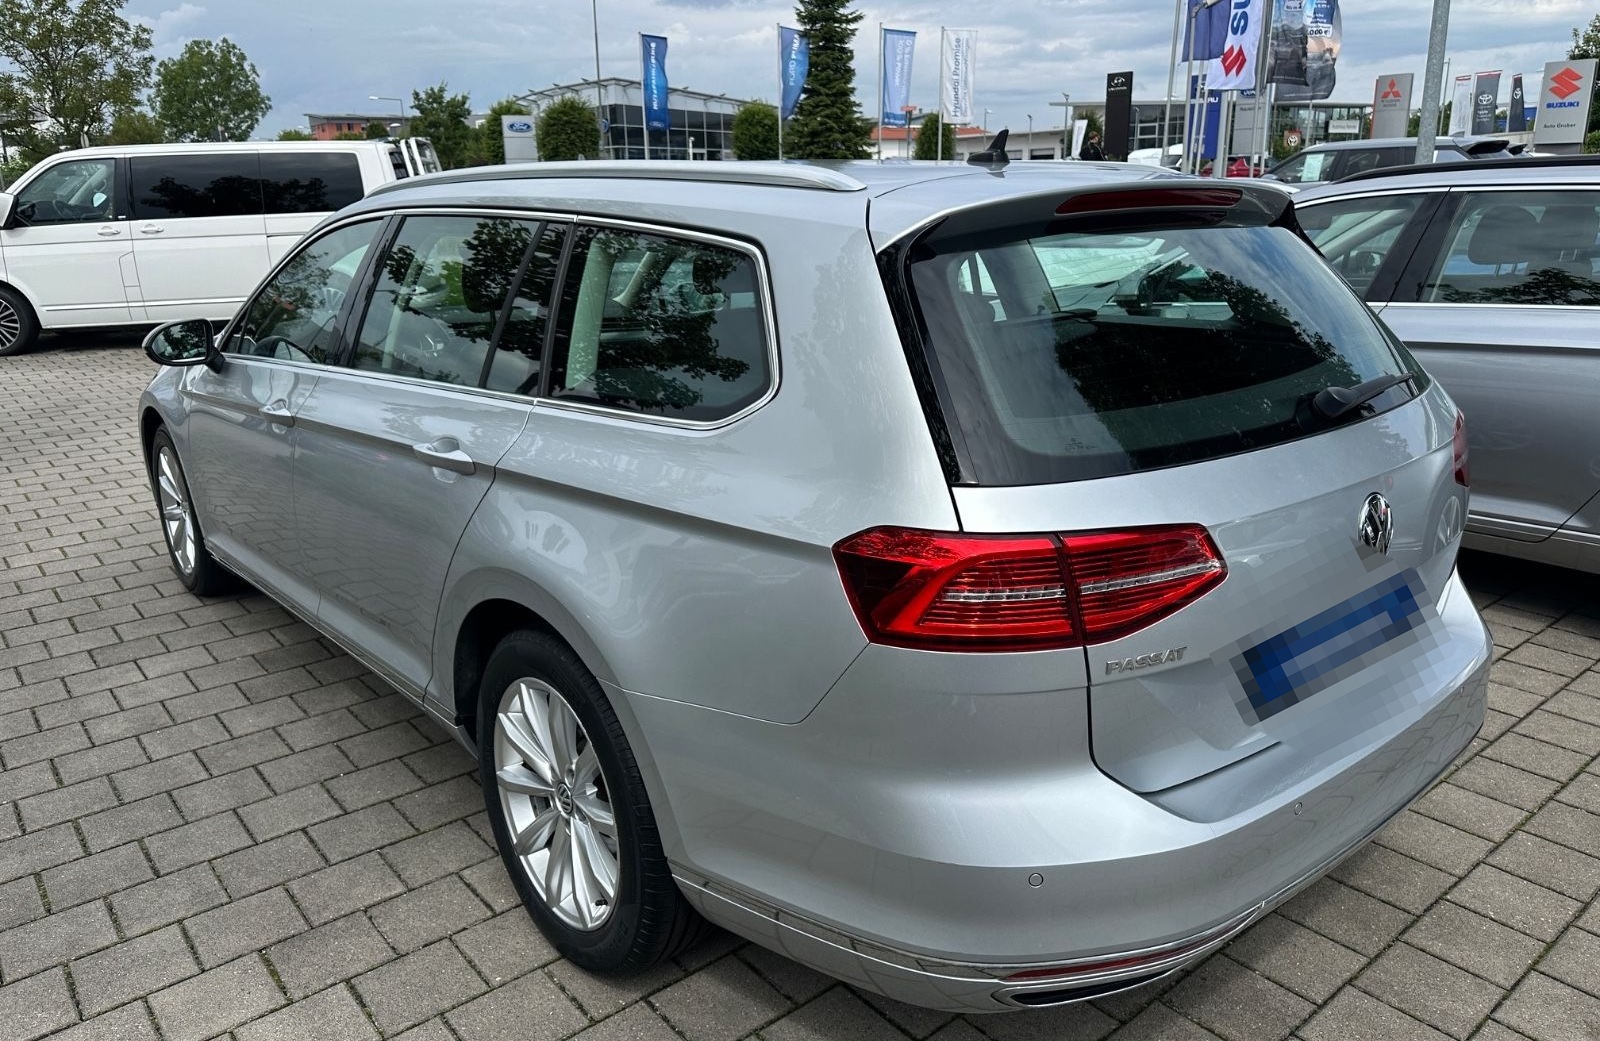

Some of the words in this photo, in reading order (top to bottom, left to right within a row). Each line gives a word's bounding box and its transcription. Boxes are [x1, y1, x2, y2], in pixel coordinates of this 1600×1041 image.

[951, 37, 961, 76] Promise
[951, 78, 961, 118] Hyundai
[1546, 101, 1580, 109] SUZUKI
[1105, 645, 1188, 676] PASSAT
